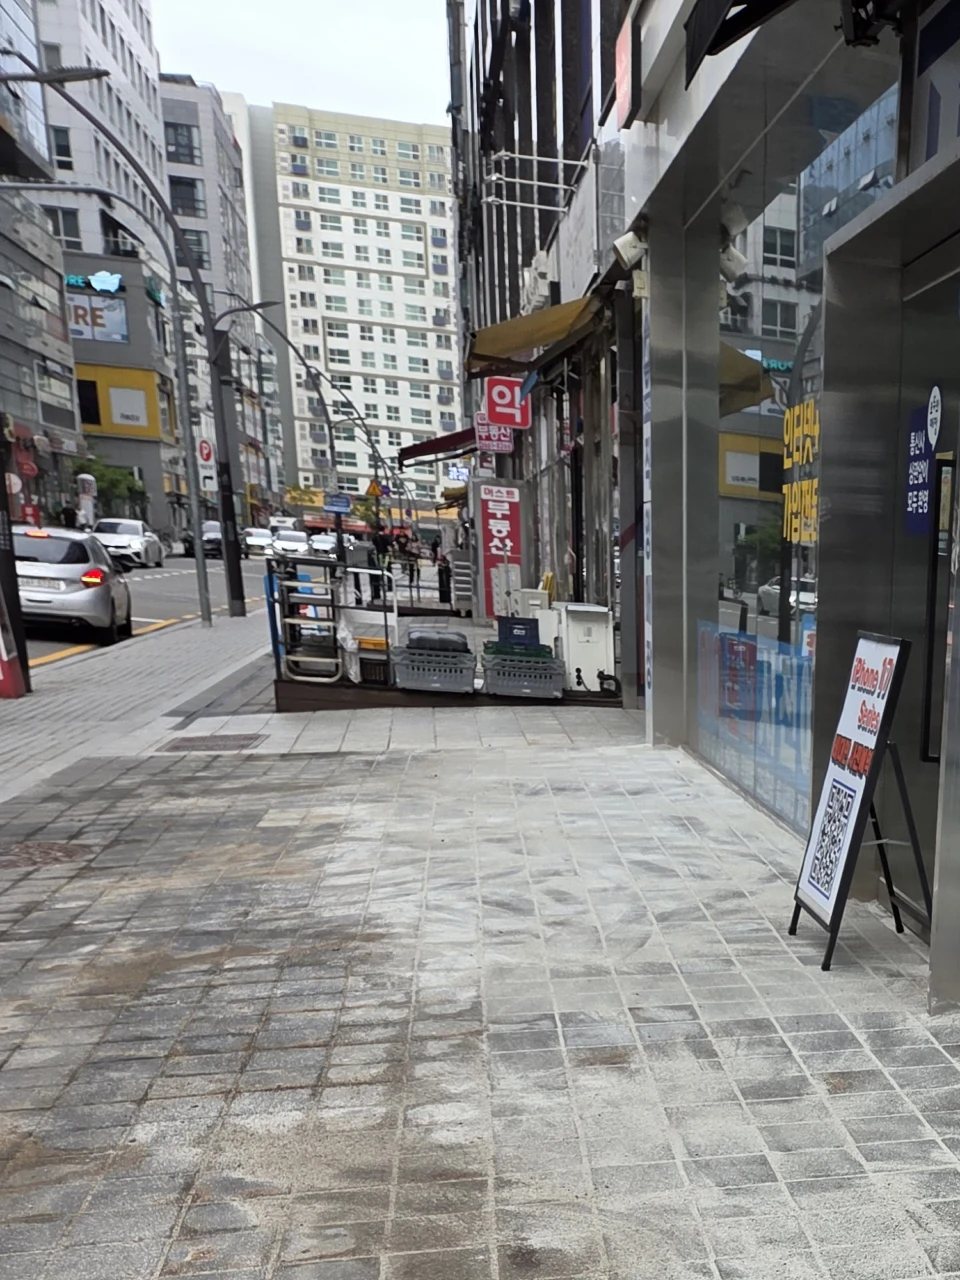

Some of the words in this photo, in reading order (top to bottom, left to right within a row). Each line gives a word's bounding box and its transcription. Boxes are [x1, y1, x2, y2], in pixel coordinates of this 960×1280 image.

[491, 384, 526, 424] 약
[783, 398, 820, 470] 인터넷
[487, 501, 514, 557] 부동산
